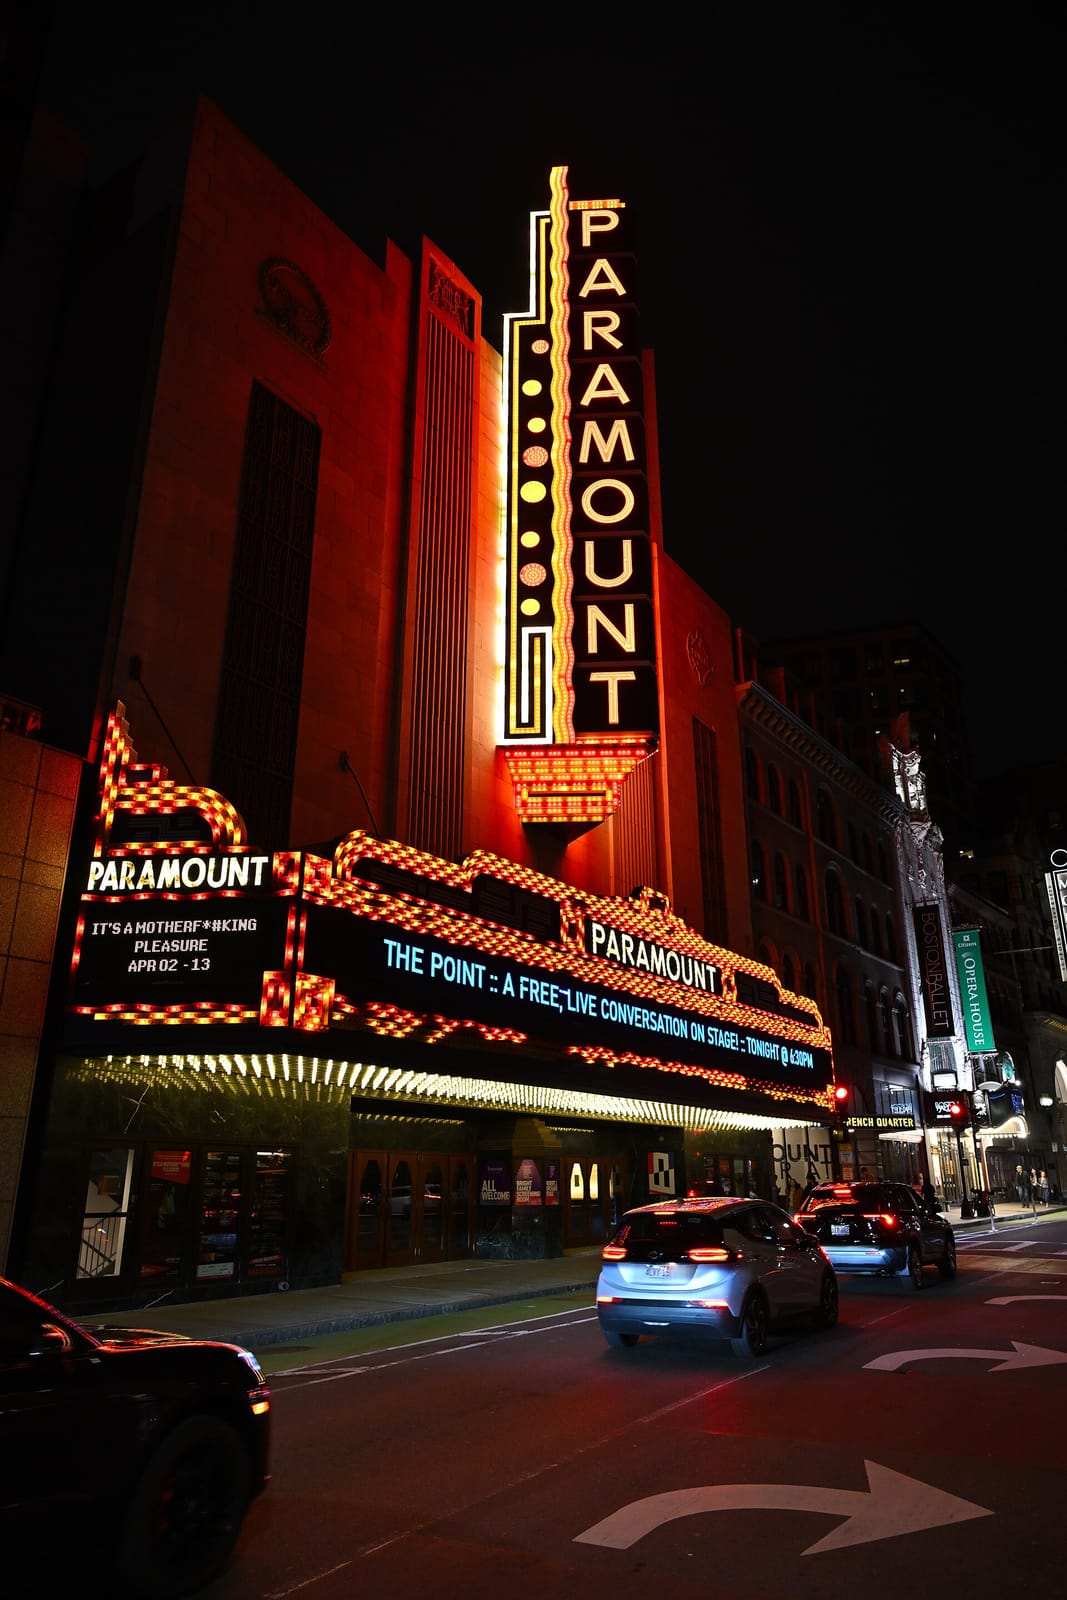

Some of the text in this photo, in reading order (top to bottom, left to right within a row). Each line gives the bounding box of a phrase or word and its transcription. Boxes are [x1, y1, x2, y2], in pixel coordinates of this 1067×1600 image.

[580, 209, 636, 725] PARAMOUNT
[87, 856, 269, 891] PARAMOUNT
[92, 922, 121, 935] IT'S
[123, 923, 133, 934] A
[134, 938, 209, 953] PLEASURE
[592, 922, 717, 993] PARAMOUNT
[128, 960, 157, 973] APR
[159, 959, 178, 972] 02
[384, 938, 424, 975] THE
[431, 952, 487, 989] POINT
[502, 972, 515, 997] A
[567, 988, 598, 1017] LIVE
[601, 998, 688, 1039] CONVERSATION
[690, 1021, 705, 1043] ON
[707, 1026, 739, 1052] STAGE!
[745, 1036, 780, 1061] TONIGHT
[780, 1046, 789, 1068] @
[963, 957, 985, 1046] OPERA HOUSE
[876, 1117, 914, 1128] QUARTER
[482, 1180, 496, 1192] ALL
[482, 1191, 510, 1200] WELCOME
